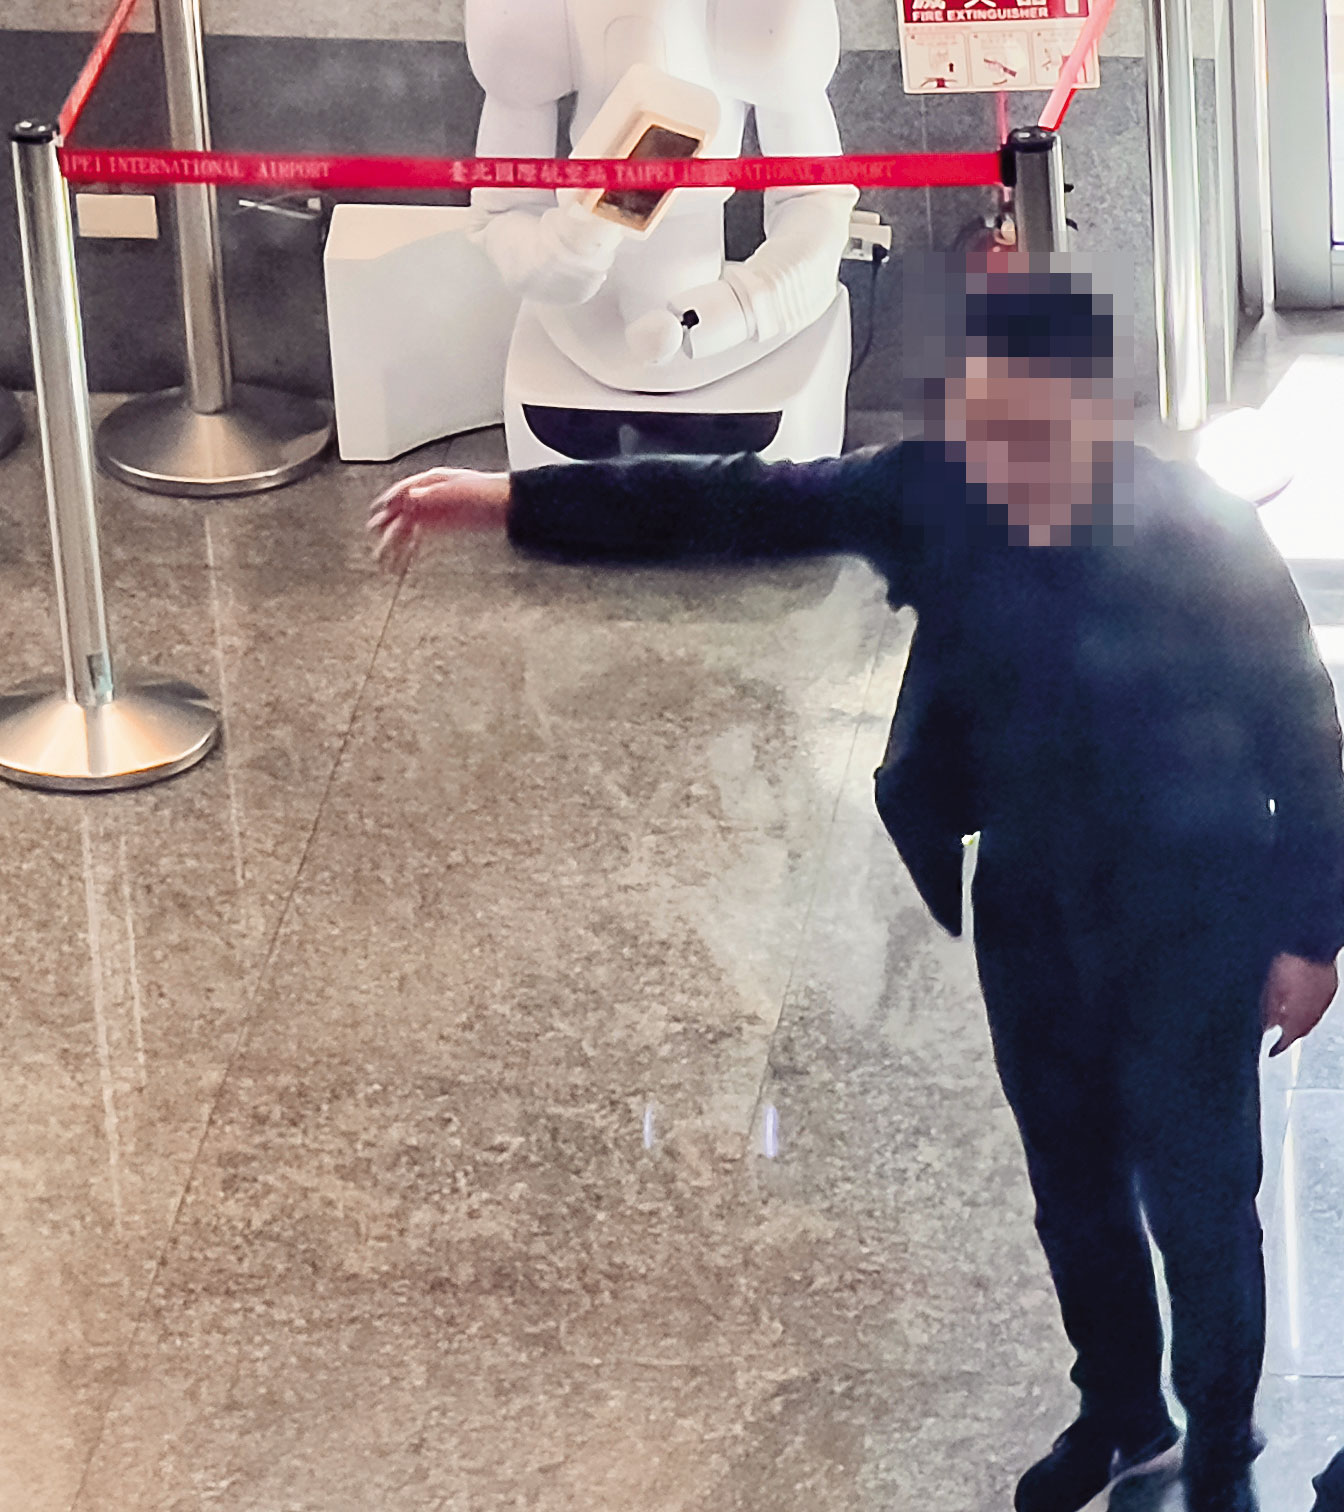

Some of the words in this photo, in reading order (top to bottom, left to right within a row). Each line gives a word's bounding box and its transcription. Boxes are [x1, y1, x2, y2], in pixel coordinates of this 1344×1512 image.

[912, 10, 944, 22] FIRE
[946, 7, 1049, 21] EXTINGUISHER
[109, 155, 241, 178] INTERNATIONAL
[258, 160, 330, 178] AIRPORT
[614, 164, 675, 182] TAIPEI
[820, 160, 896, 180] AIRPORT
